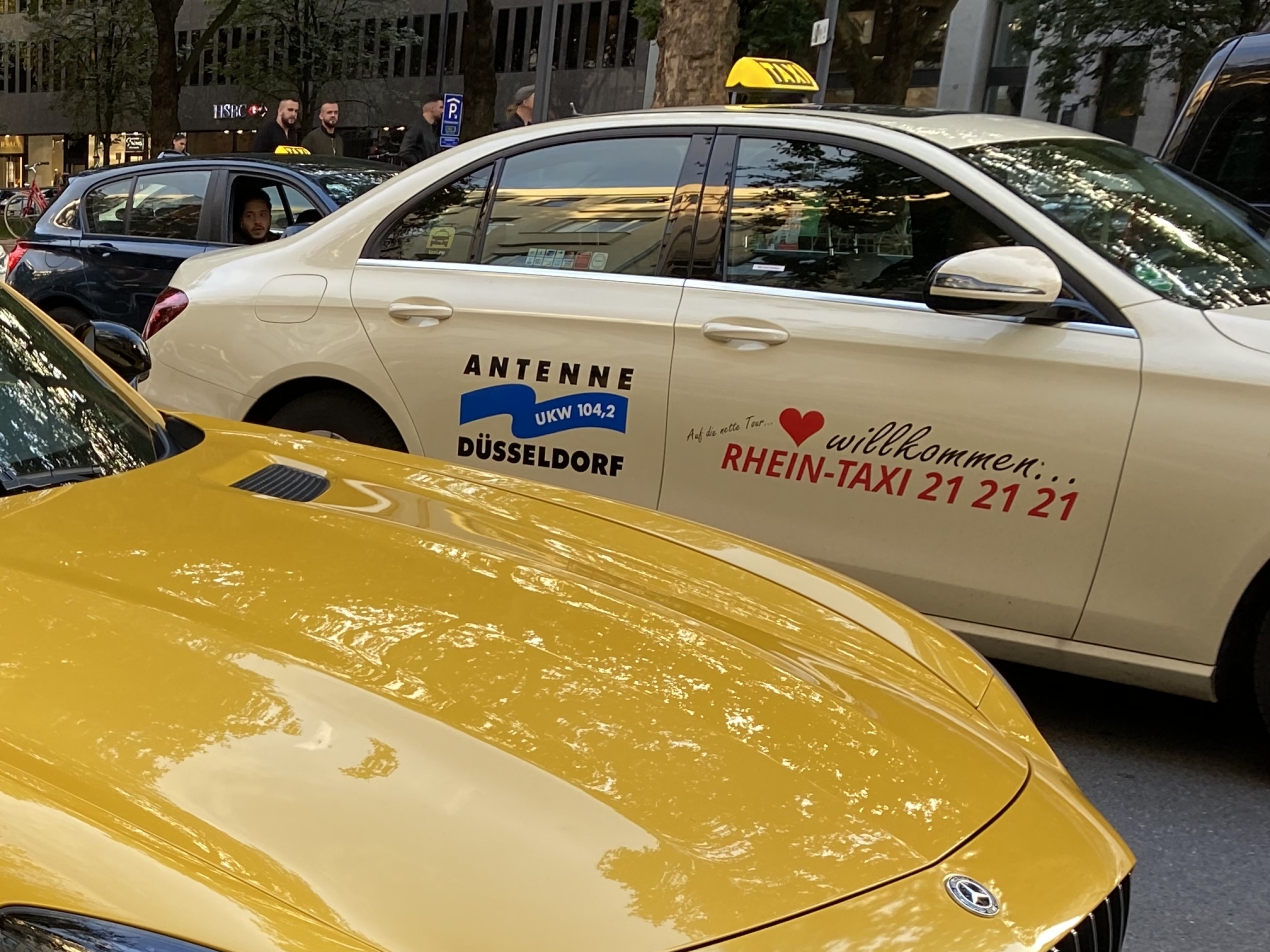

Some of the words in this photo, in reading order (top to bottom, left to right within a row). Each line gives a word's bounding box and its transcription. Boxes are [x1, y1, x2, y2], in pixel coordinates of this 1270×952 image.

[757, 61, 813, 85] TAXI
[213, 104, 247, 119] HSBC
[448, 103, 458, 119] P
[463, 354, 634, 391] ANTENNE
[535, 405, 572, 426] UKW
[577, 402, 616, 419] 104,2
[687, 427, 704, 443] Auf
[705, 427, 717, 438] die
[720, 422, 741, 435] nette
[457, 432, 625, 478] DÜSSELDORF
[721, 442, 913, 498] RHEIN-TAXI
[917, 471, 965, 505] 21
[971, 479, 1021, 513] 21
[1027, 487, 1080, 522] 21
